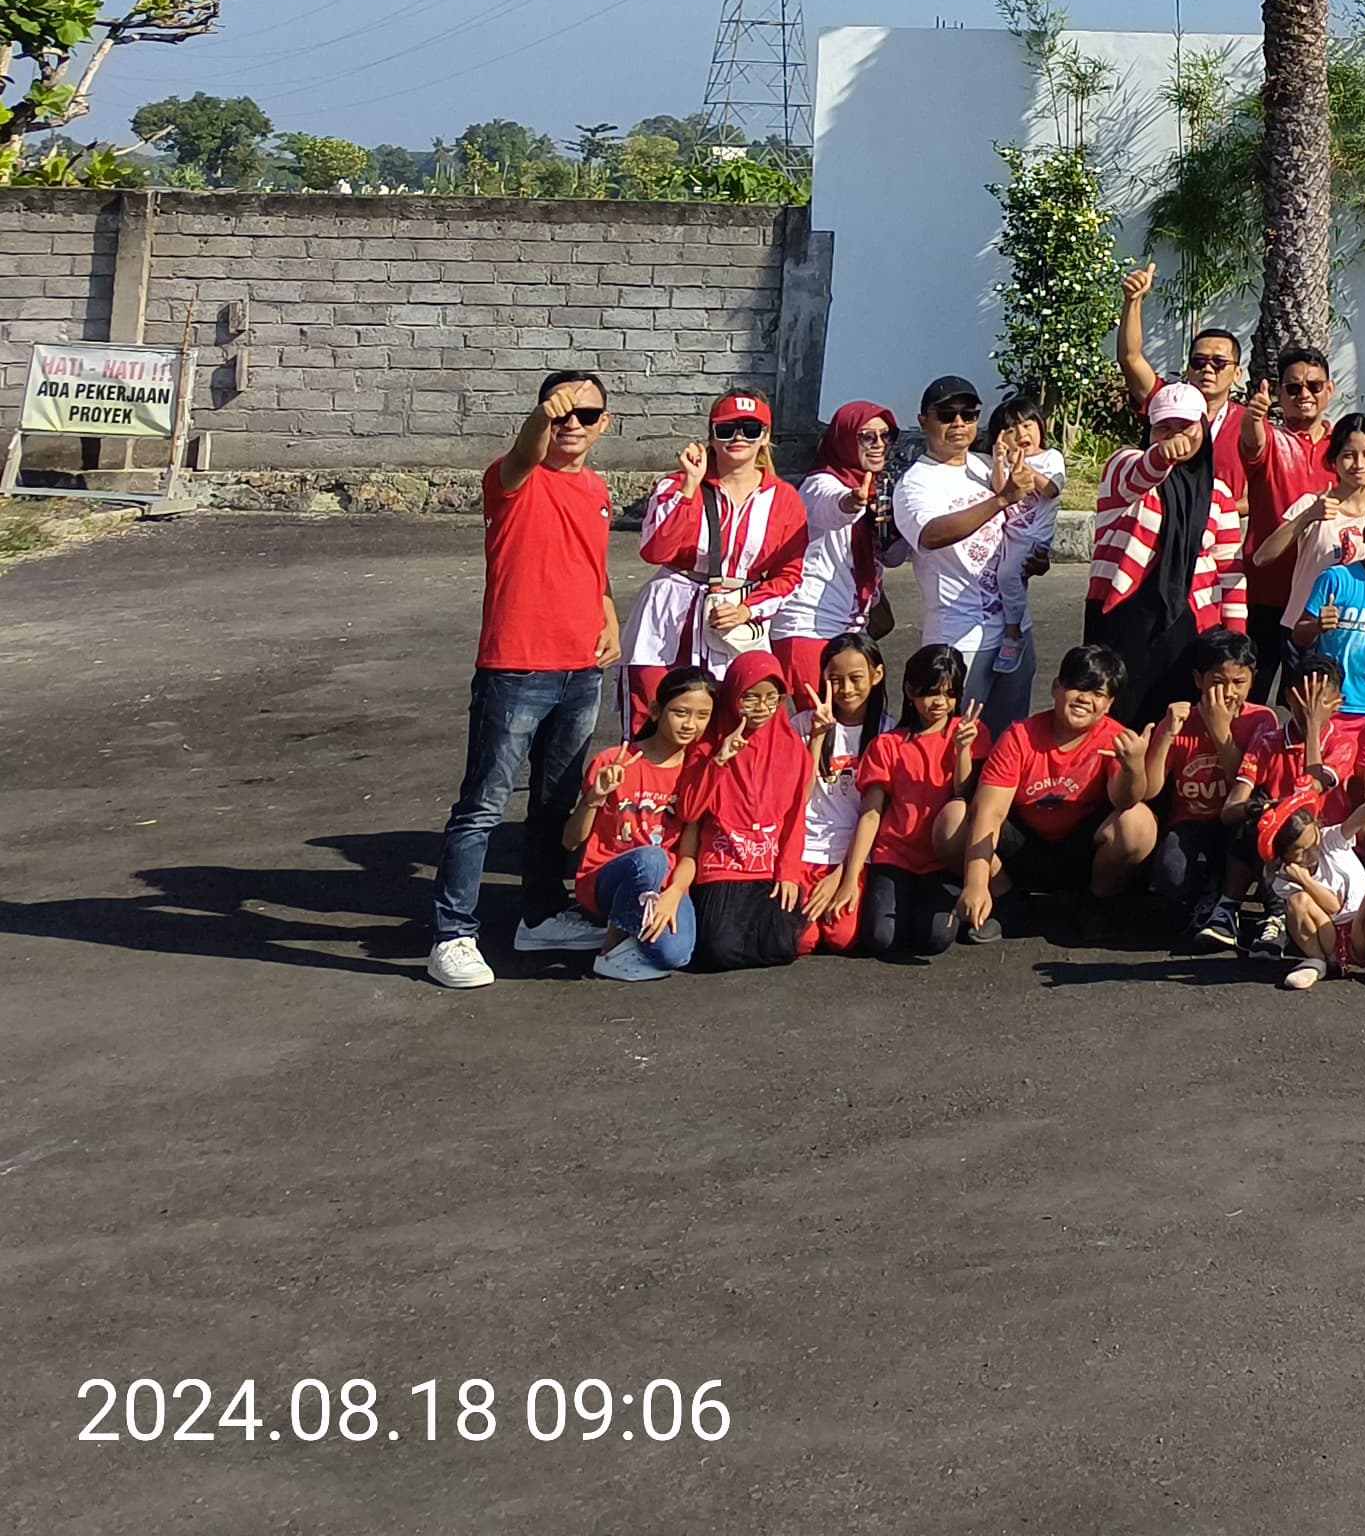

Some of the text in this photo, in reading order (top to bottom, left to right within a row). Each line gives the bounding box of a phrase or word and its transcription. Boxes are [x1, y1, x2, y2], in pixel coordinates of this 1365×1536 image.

[42, 355, 84, 377] HATI
[102, 359, 147, 381] HATI
[36, 381, 171, 404] ADA PEKERJAAN
[69, 406, 134, 425] PROYEK
